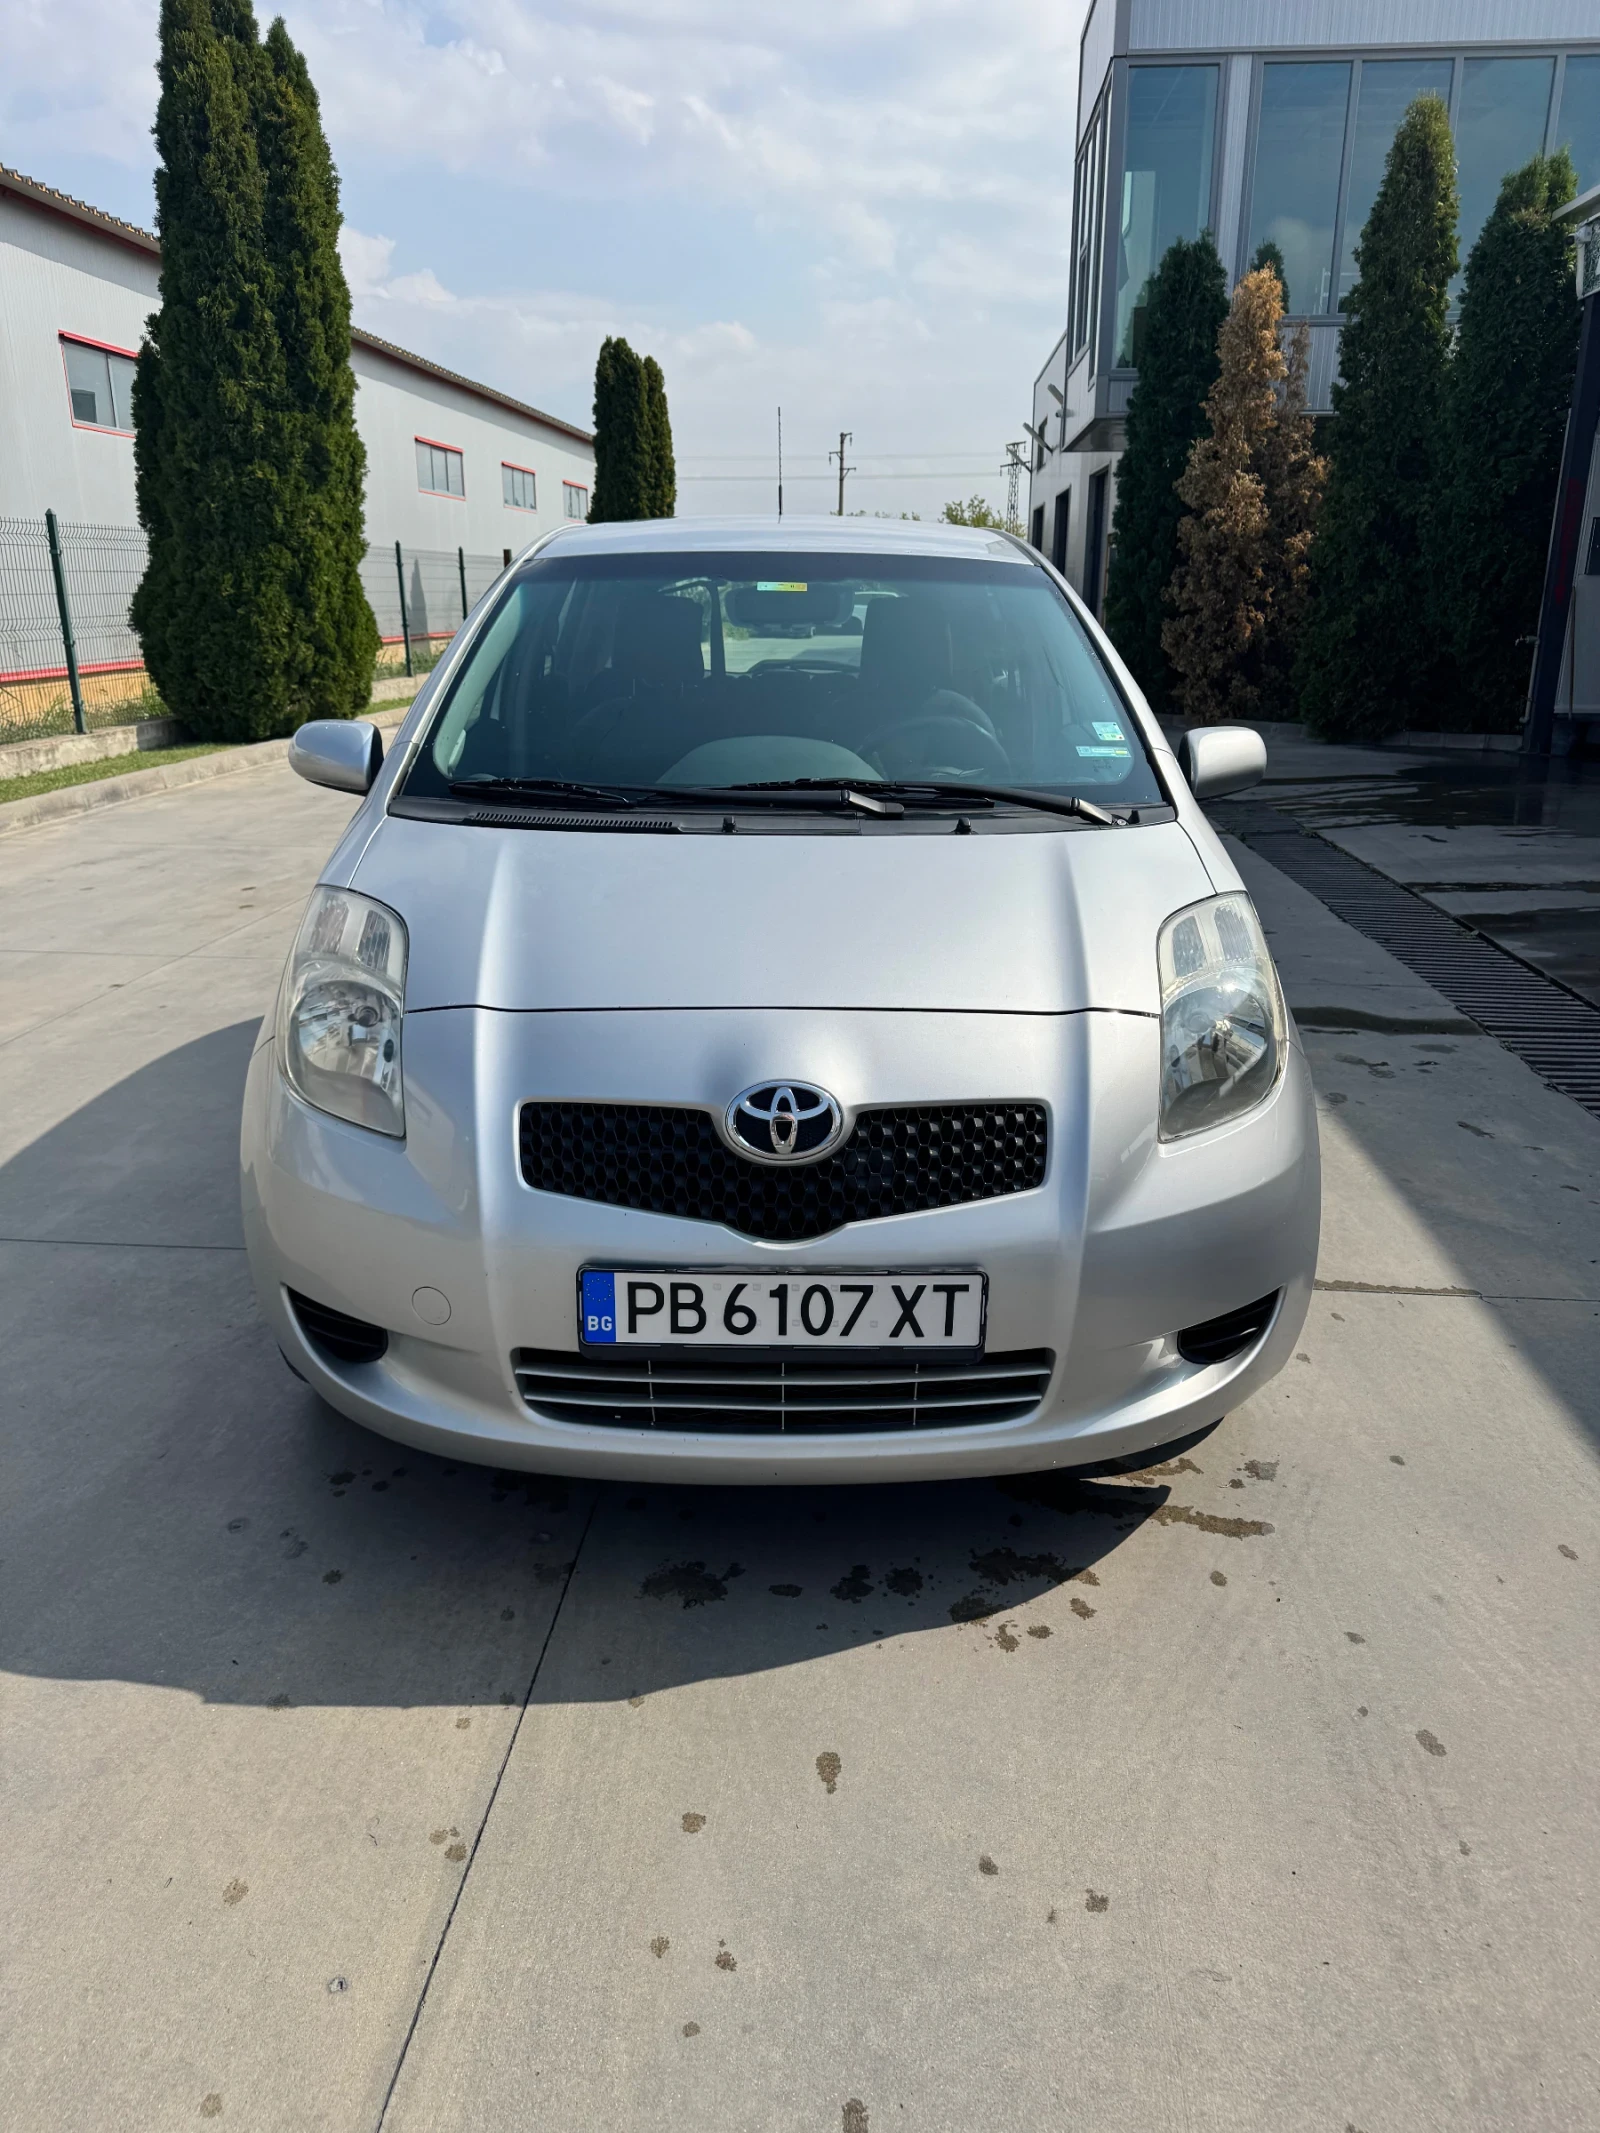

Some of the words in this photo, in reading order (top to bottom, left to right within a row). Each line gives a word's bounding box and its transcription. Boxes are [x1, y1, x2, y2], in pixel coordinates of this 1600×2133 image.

[587, 1315, 612, 1332] BG
[627, 1281, 707, 1335] PB
[723, 1283, 874, 1337] 6107
[888, 1284, 970, 1339] XT
